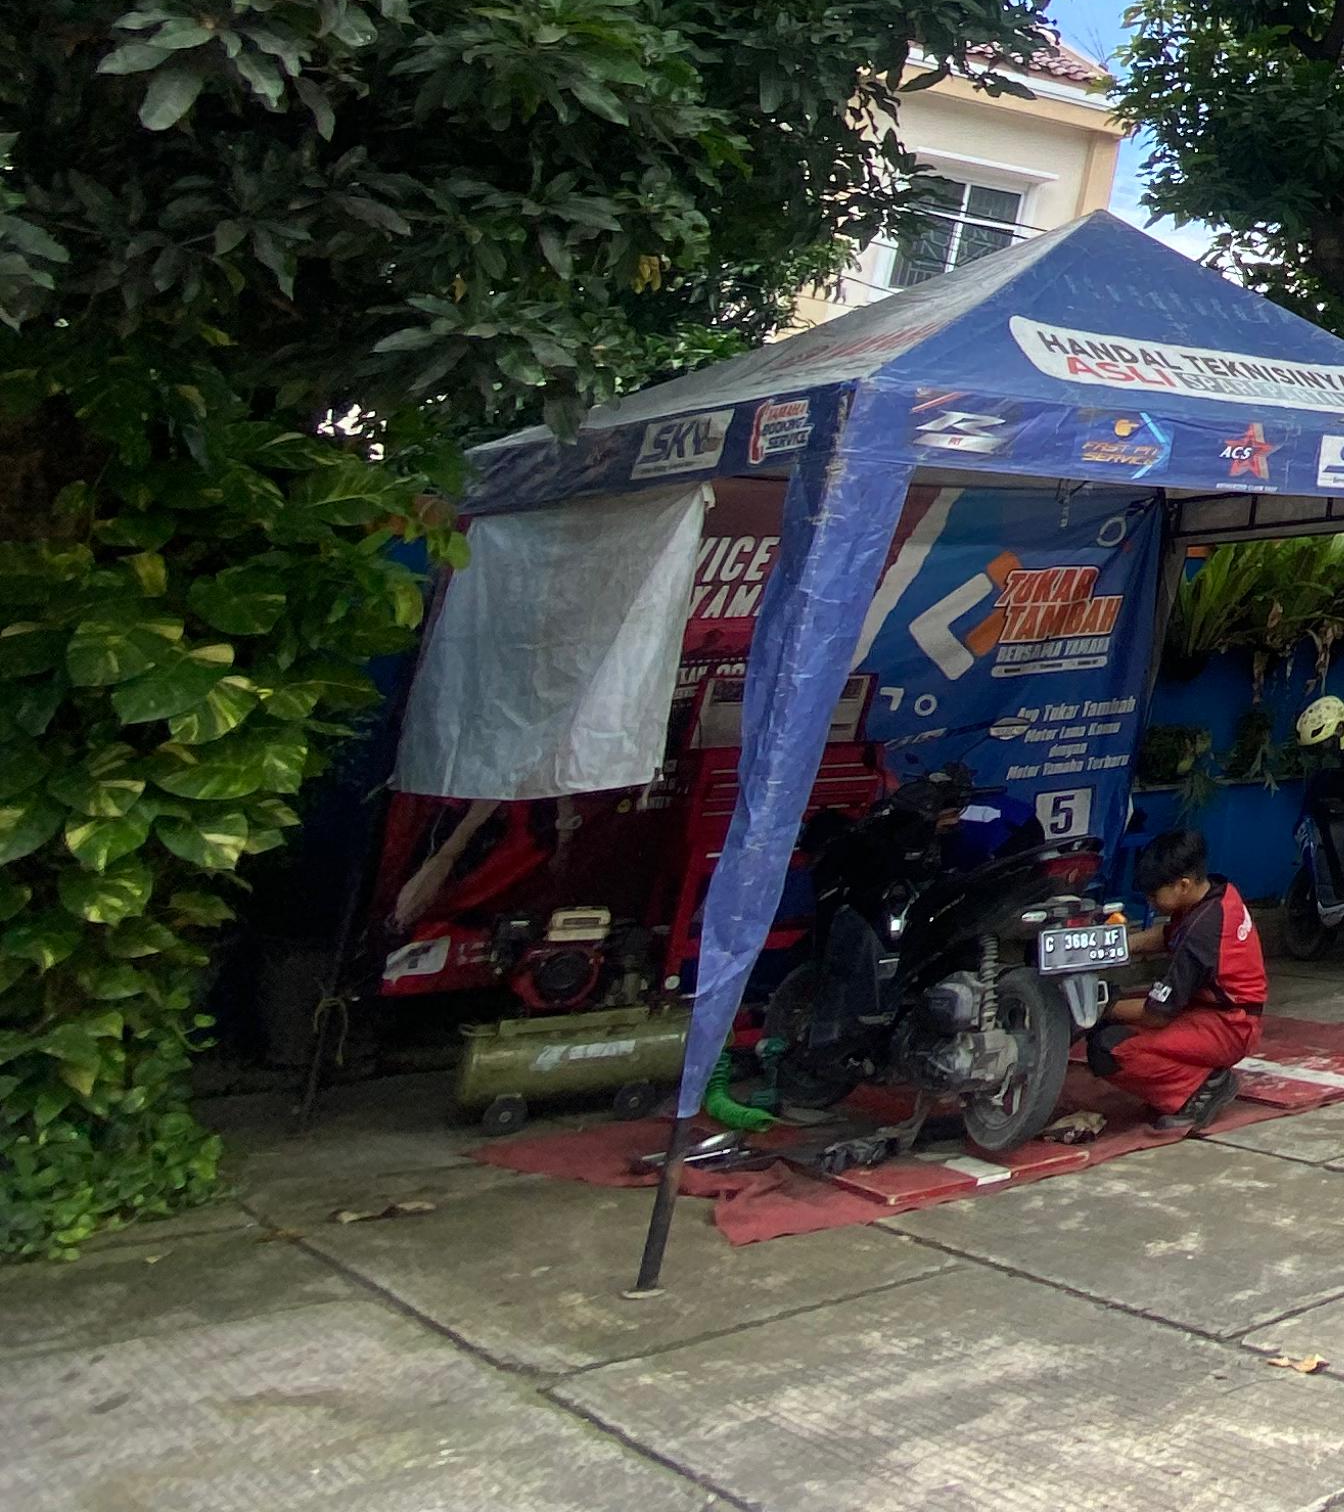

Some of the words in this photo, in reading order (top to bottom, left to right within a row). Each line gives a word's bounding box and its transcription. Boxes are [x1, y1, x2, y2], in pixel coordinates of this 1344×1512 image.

[1037, 330, 1183, 371] HANDAL
[1066, 356, 1177, 388] ASLI
[1218, 445, 1253, 460] ACS
[997, 567, 1098, 606] TUKAR
[999, 597, 1122, 642] TAMBAH
[1049, 793, 1076, 835] 5
[1064, 932, 1097, 950] 3684
[1104, 929, 1119, 946] XF
